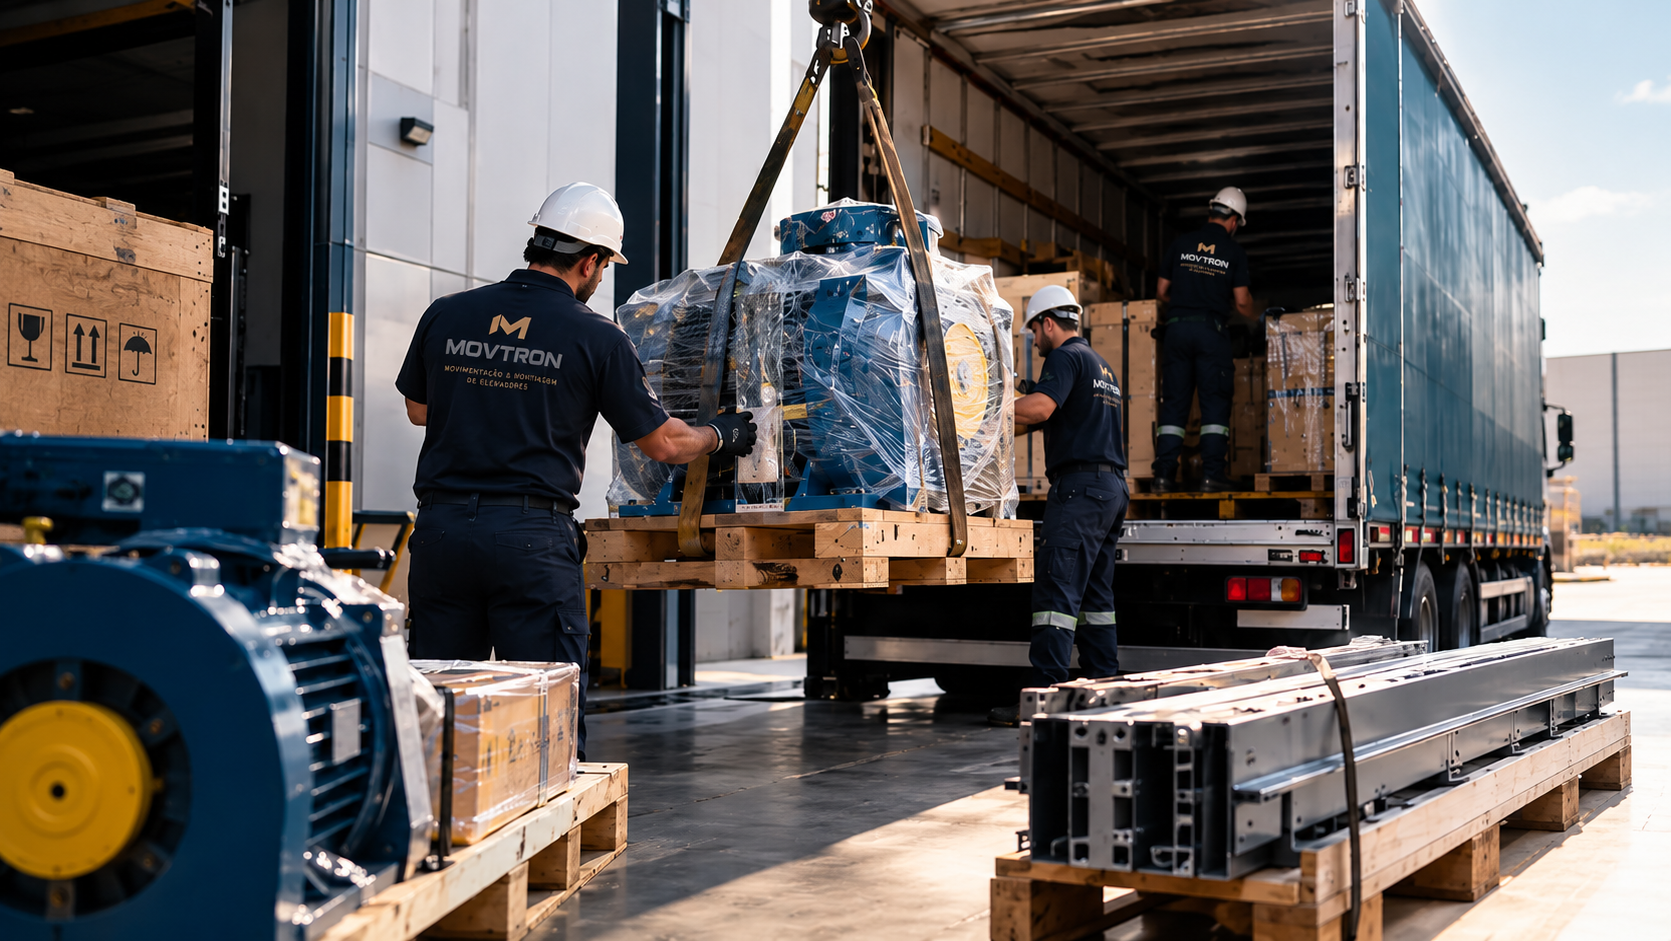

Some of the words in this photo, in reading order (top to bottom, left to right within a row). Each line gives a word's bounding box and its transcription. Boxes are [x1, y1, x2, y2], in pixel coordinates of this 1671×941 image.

[1180, 253, 1229, 269] MOVTRON
[488, 314, 532, 340] M
[445, 338, 563, 369] MOVTRON
